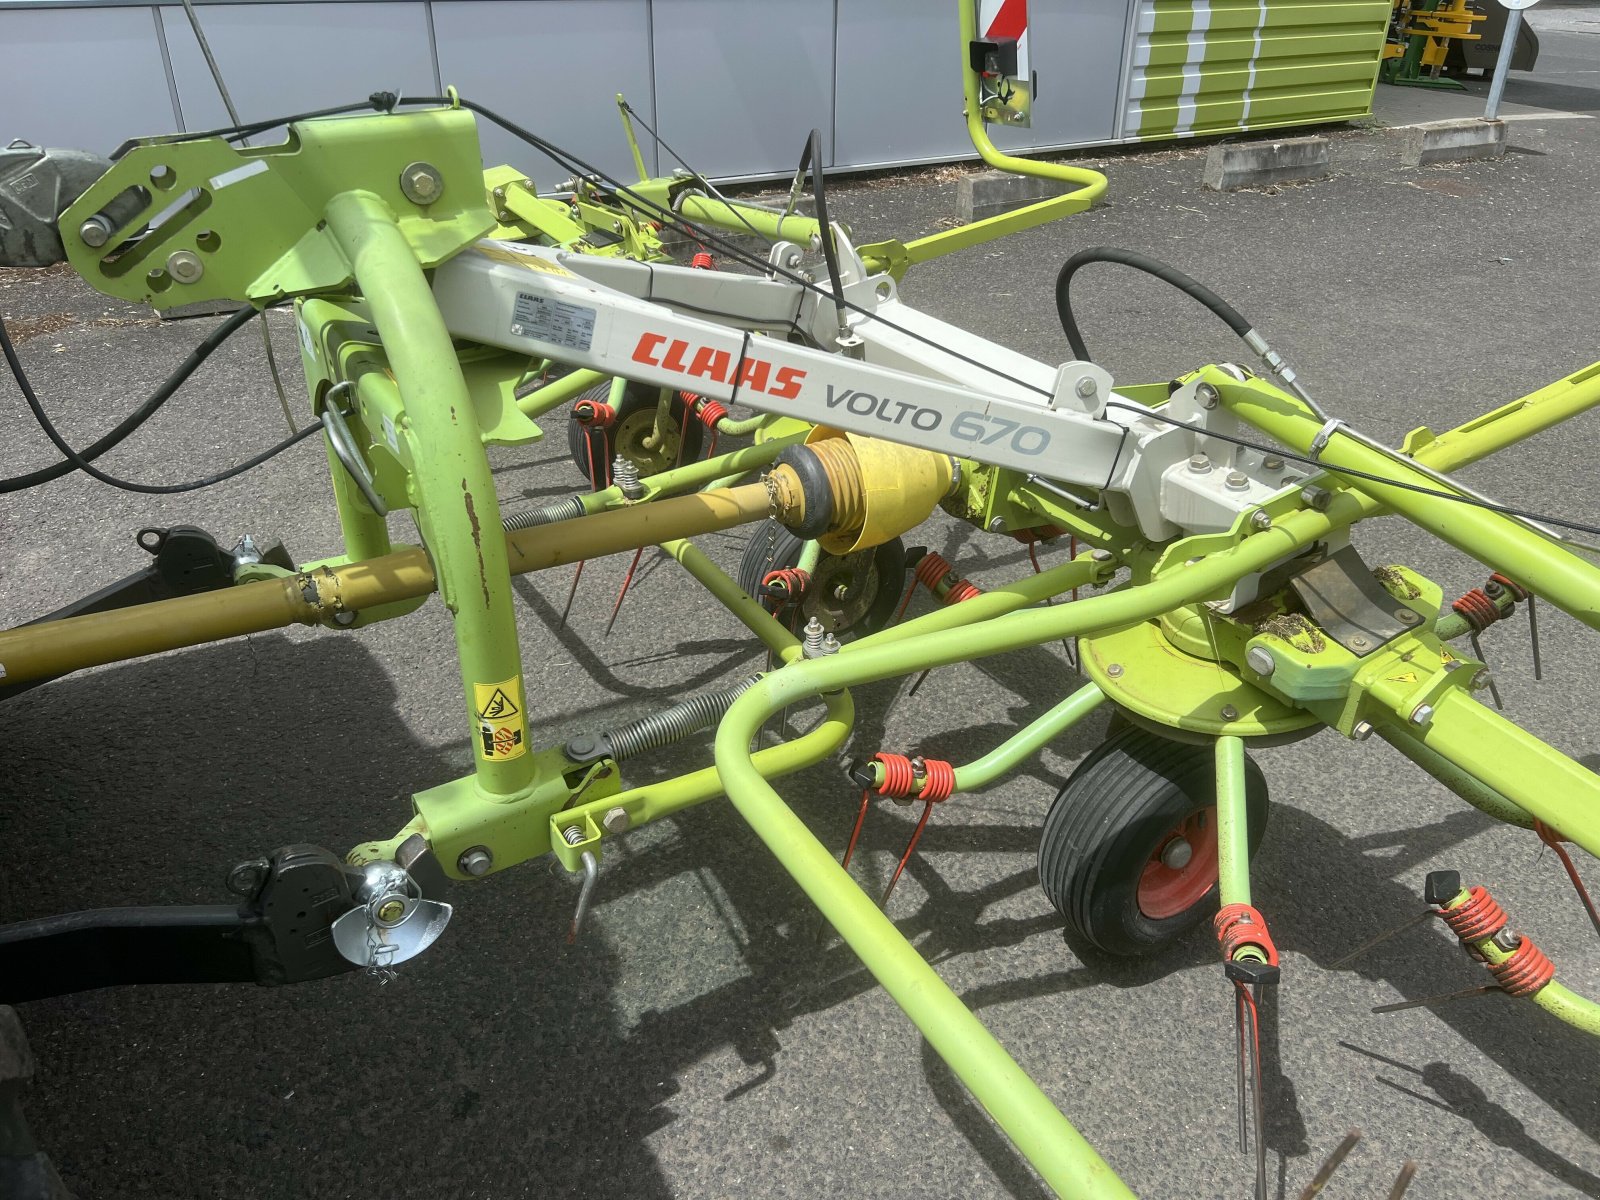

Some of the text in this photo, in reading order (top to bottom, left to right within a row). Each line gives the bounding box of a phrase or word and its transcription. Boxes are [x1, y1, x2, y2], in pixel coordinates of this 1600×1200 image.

[632, 332, 1051, 456] CLAAS VOLTO 670
